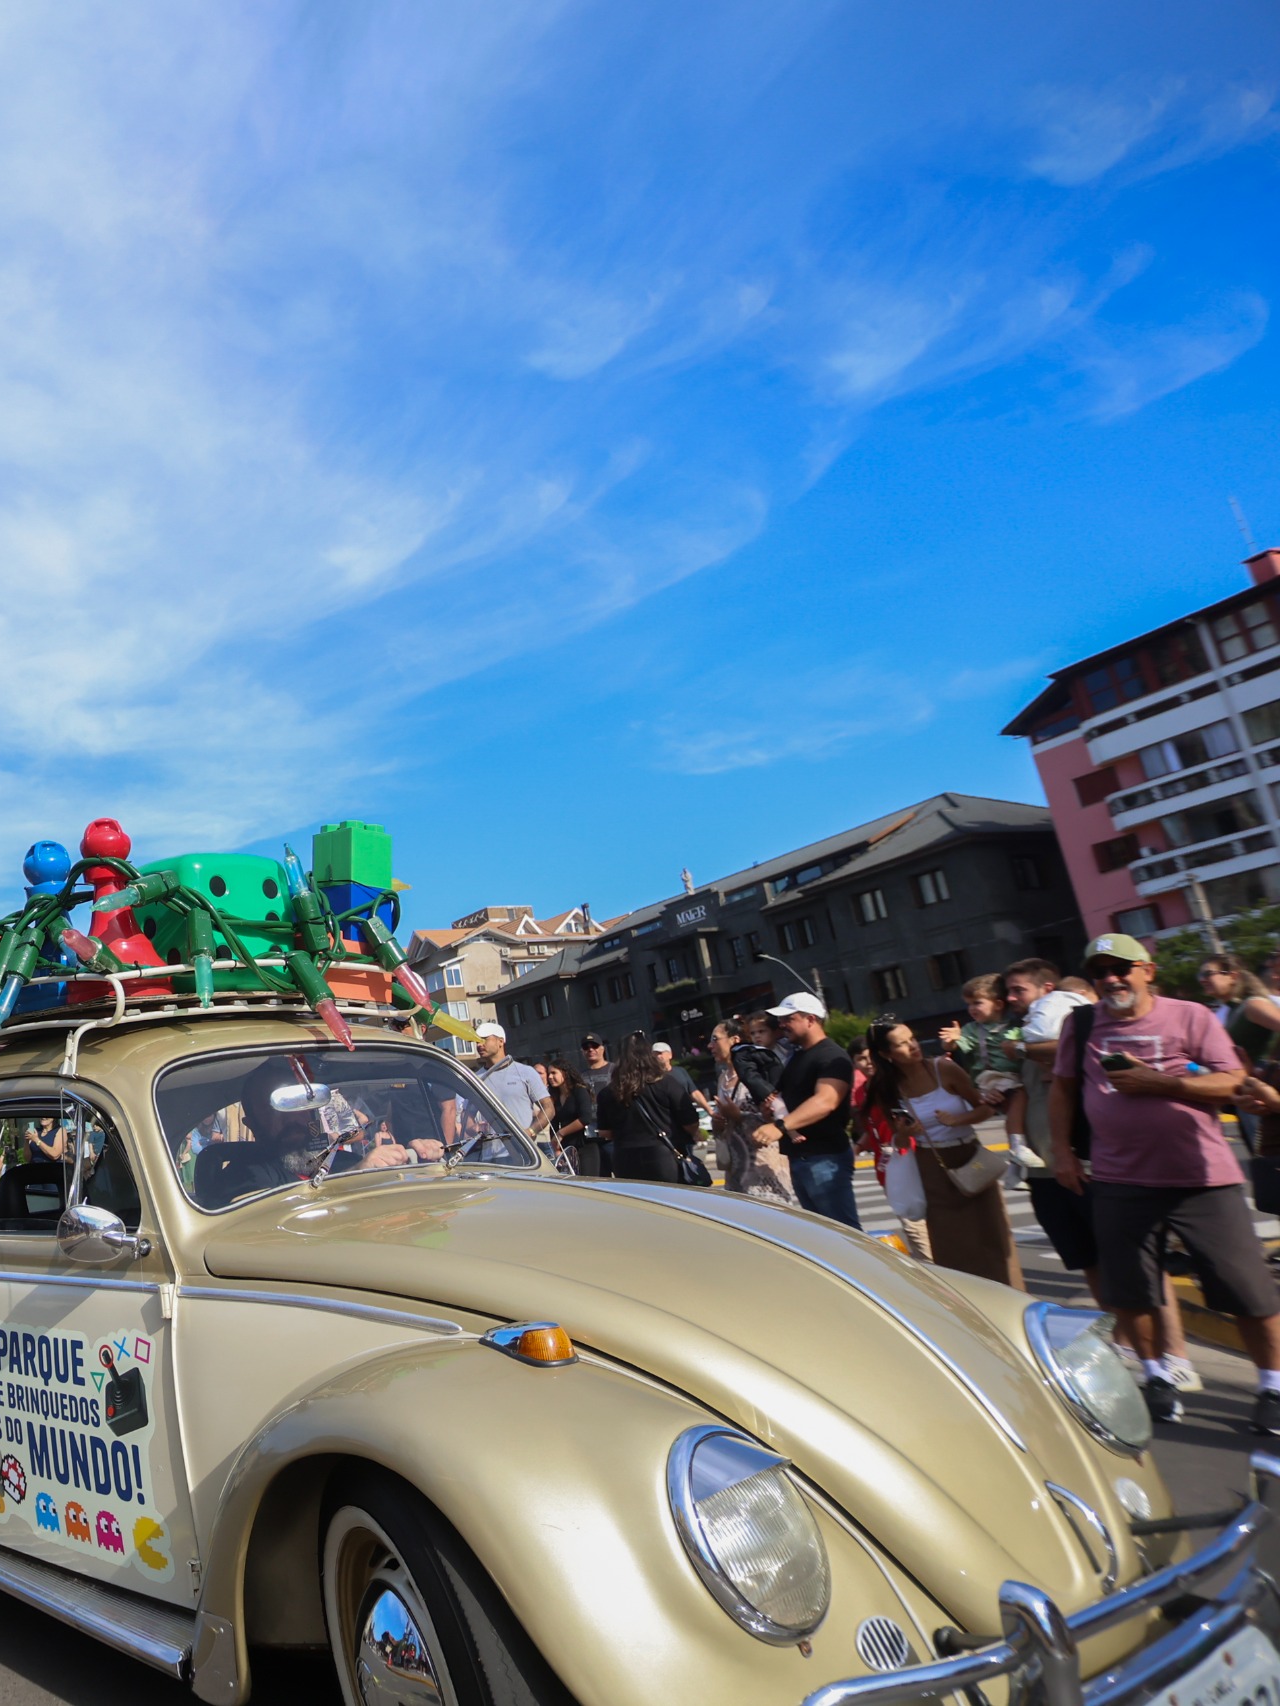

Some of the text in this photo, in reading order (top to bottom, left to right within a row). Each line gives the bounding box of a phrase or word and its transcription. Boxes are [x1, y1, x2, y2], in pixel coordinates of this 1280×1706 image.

[8, 1384, 101, 1429] BRINQUEDOS
[5, 1414, 23, 1446] DO
[26, 1420, 146, 1506] MUNDO!
